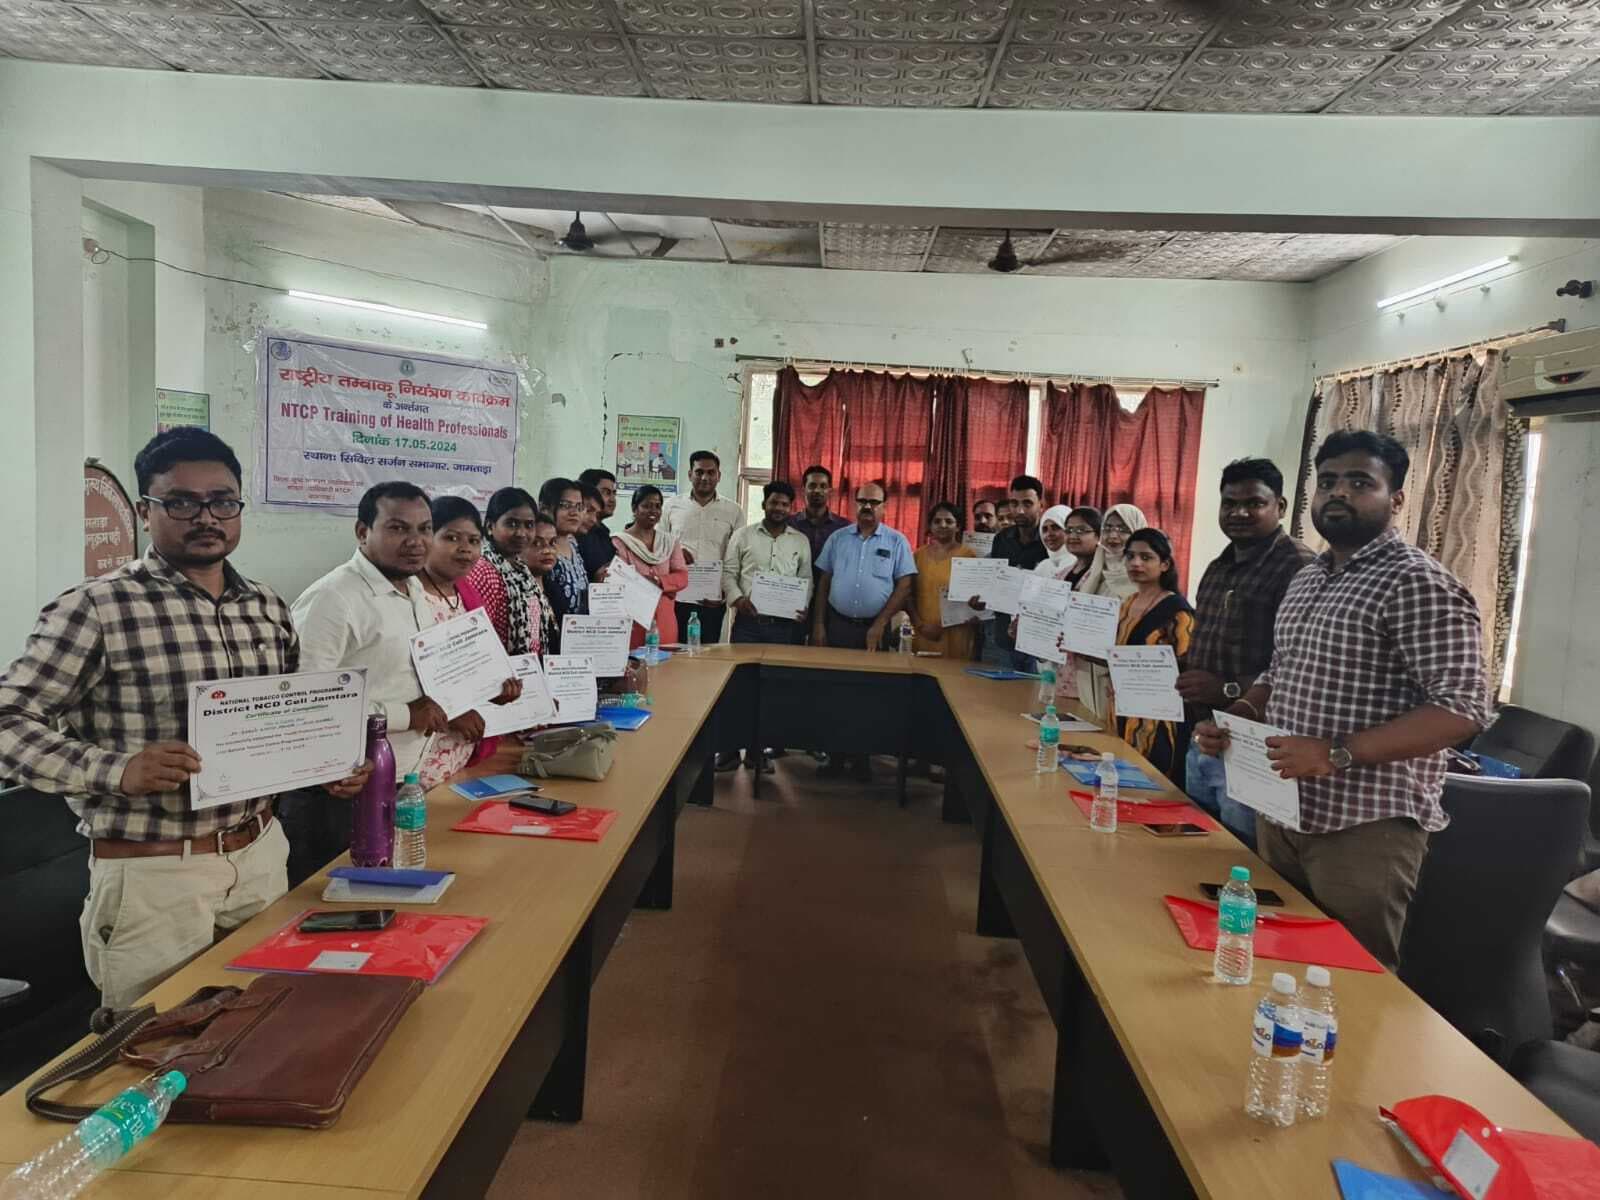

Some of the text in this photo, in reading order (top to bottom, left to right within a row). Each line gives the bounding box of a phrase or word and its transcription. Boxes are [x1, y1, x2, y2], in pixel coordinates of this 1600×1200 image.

[279, 366, 334, 388] राष्ट्रीय
[399, 379, 452, 400] नियंत्रण
[281, 402, 508, 440] NTCP Training of Health Professionals
[352, 431, 457, 453] दिनांक 17.05.2024
[203, 692, 358, 717] District NCD Cell Jamtara
[220, 697, 250, 706] NATIONAL
